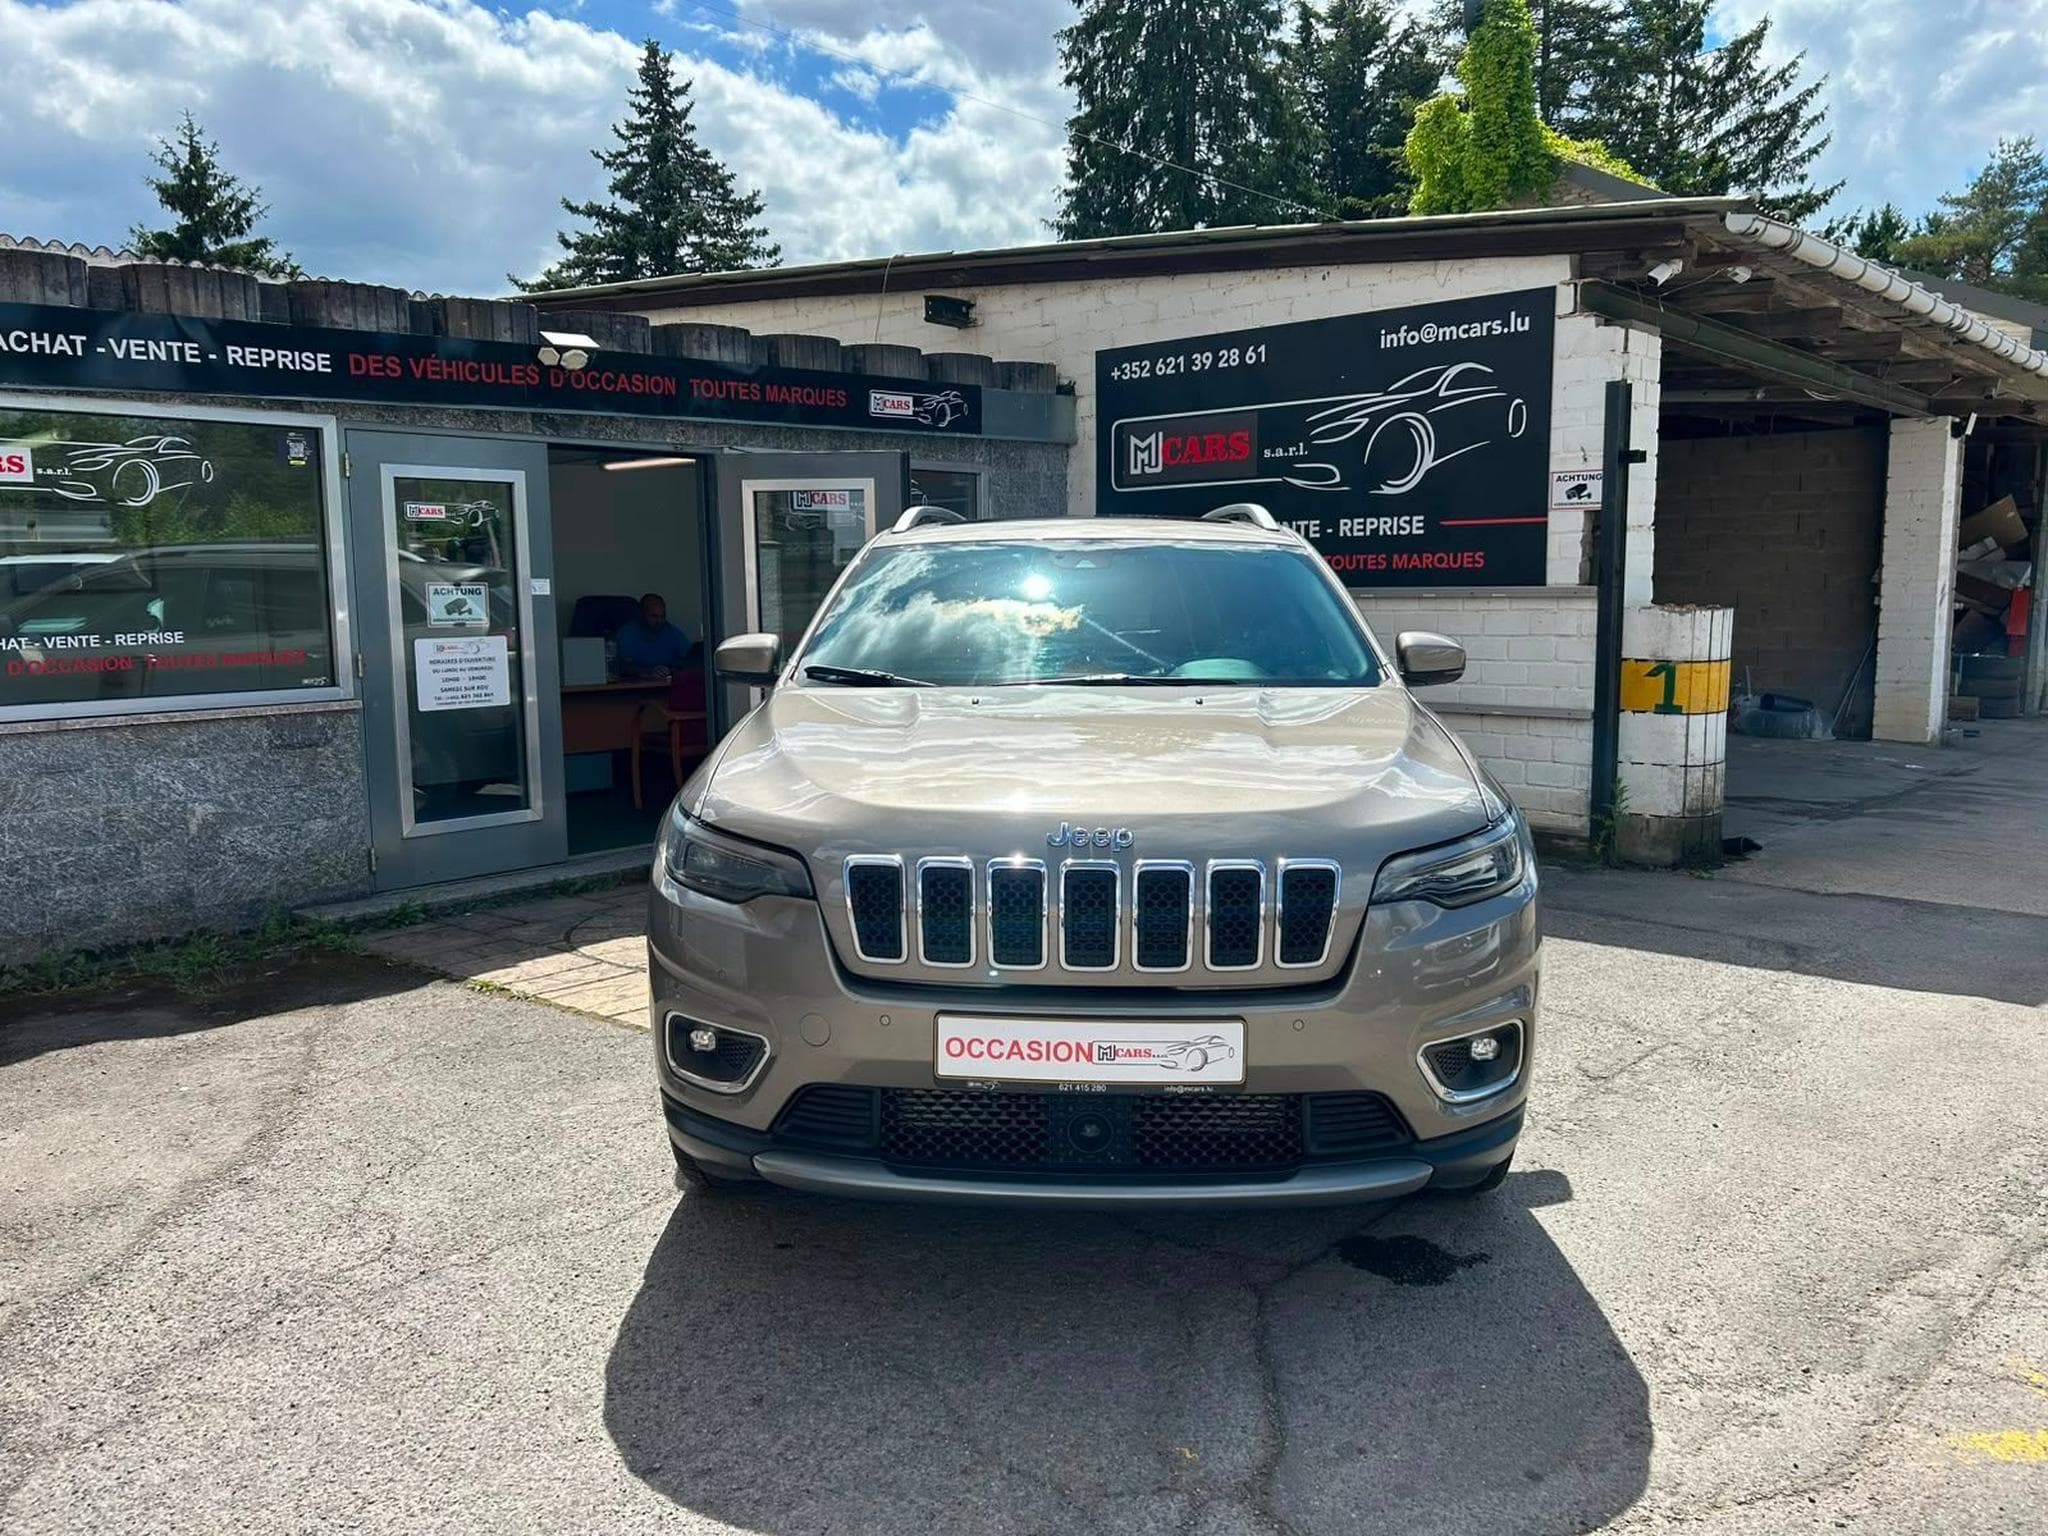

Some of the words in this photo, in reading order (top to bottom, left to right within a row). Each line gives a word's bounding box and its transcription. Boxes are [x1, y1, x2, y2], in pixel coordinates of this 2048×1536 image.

[1380, 310, 1530, 349] info@mcars.lu
[1111, 360, 1151, 381] +352
[1155, 354, 1185, 376] 621
[1191, 351, 1213, 372] 39
[1218, 348, 1239, 368] 28
[1245, 344, 1266, 364] 61
[227, 345, 332, 373] REPRISE
[349, 353, 401, 377] DES
[409, 354, 540, 386] VÉHICULES
[550, 369, 677, 396] D'OCCASION
[689, 379, 761, 401] TOUTES
[766, 384, 848, 408] MARQUES
[1263, 443, 1308, 459] s.a.r.l.
[1555, 473, 1603, 482] ACHTUNG
[1339, 515, 1425, 537] REPRISE
[1392, 552, 1485, 570] MARQUES
[432, 587, 482, 596] ACHTUNG
[44, 634, 100, 649] VENTE
[115, 631, 185, 646] REPRISE
[1643, 663, 1683, 714] 1
[1046, 821, 1134, 852] Jeep
[945, 1036, 1093, 1063] OCCASION
